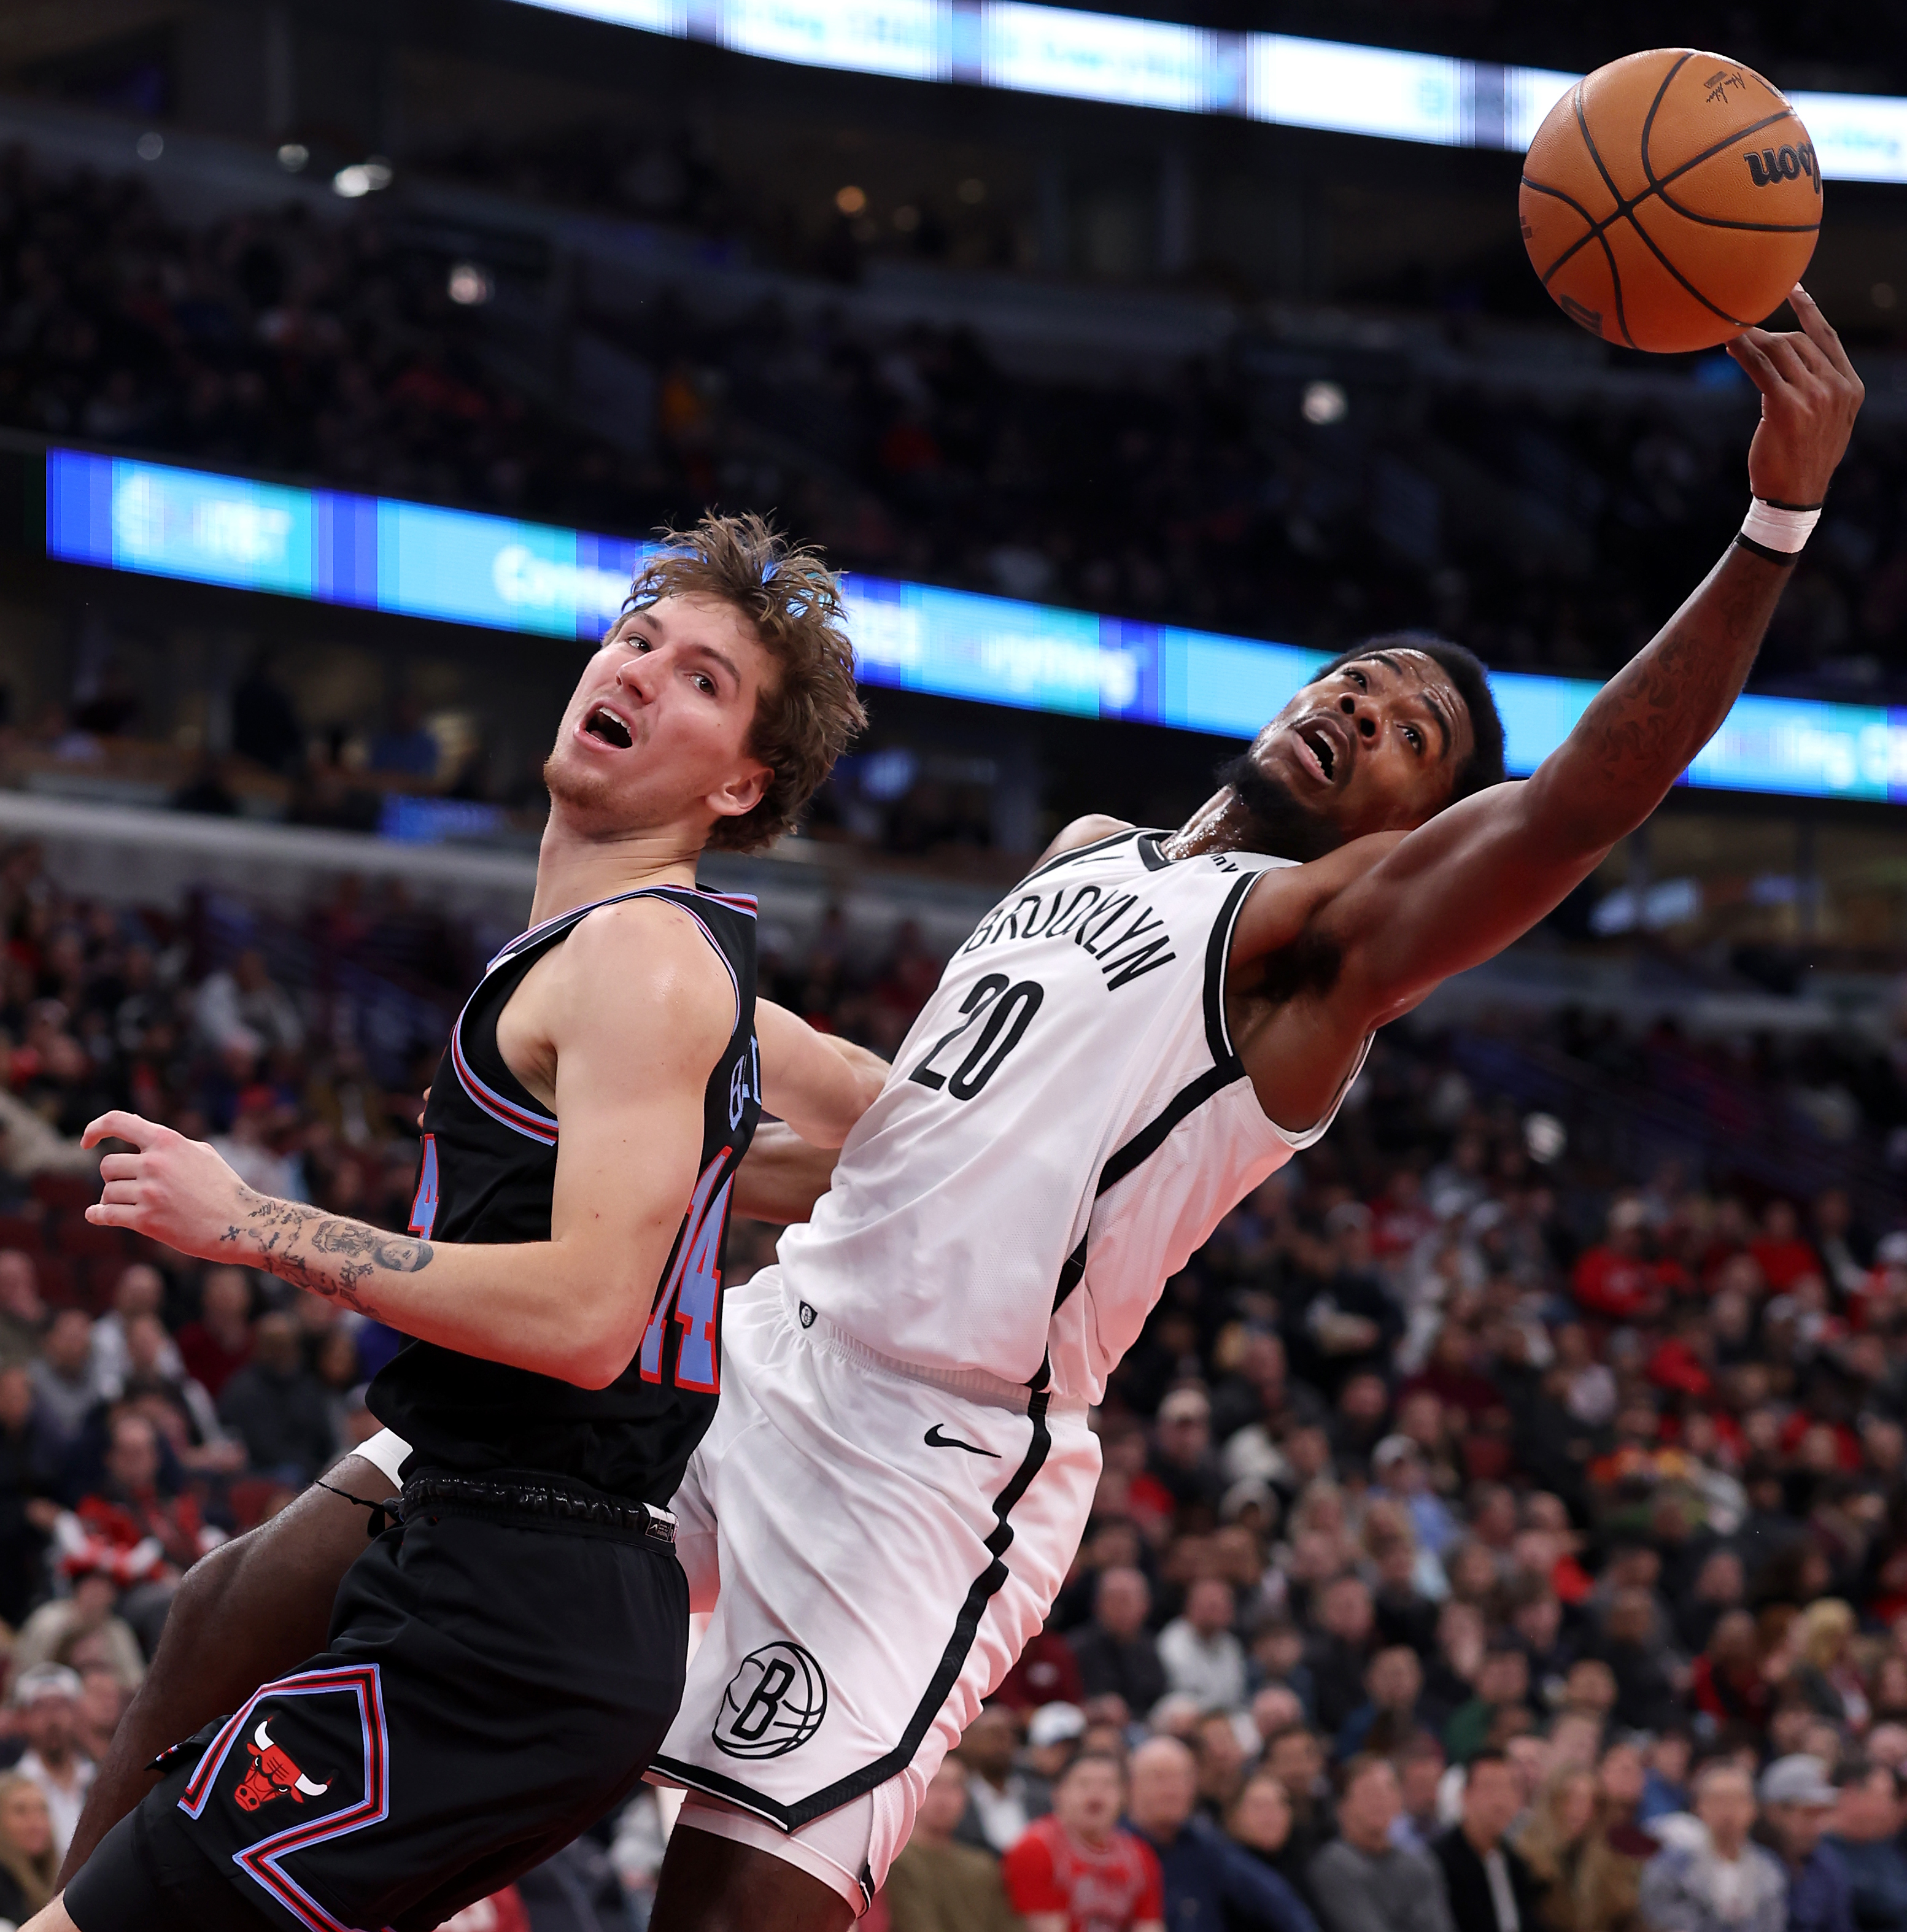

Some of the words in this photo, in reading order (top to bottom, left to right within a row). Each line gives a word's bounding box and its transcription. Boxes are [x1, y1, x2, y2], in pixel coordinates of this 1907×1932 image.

[962, 886, 1177, 992] BROOKLYN
[908, 973, 1044, 1101] 20
[408, 1132, 439, 1240] 4
[640, 1145, 736, 1395] 14
[730, 1658, 795, 1741] B
